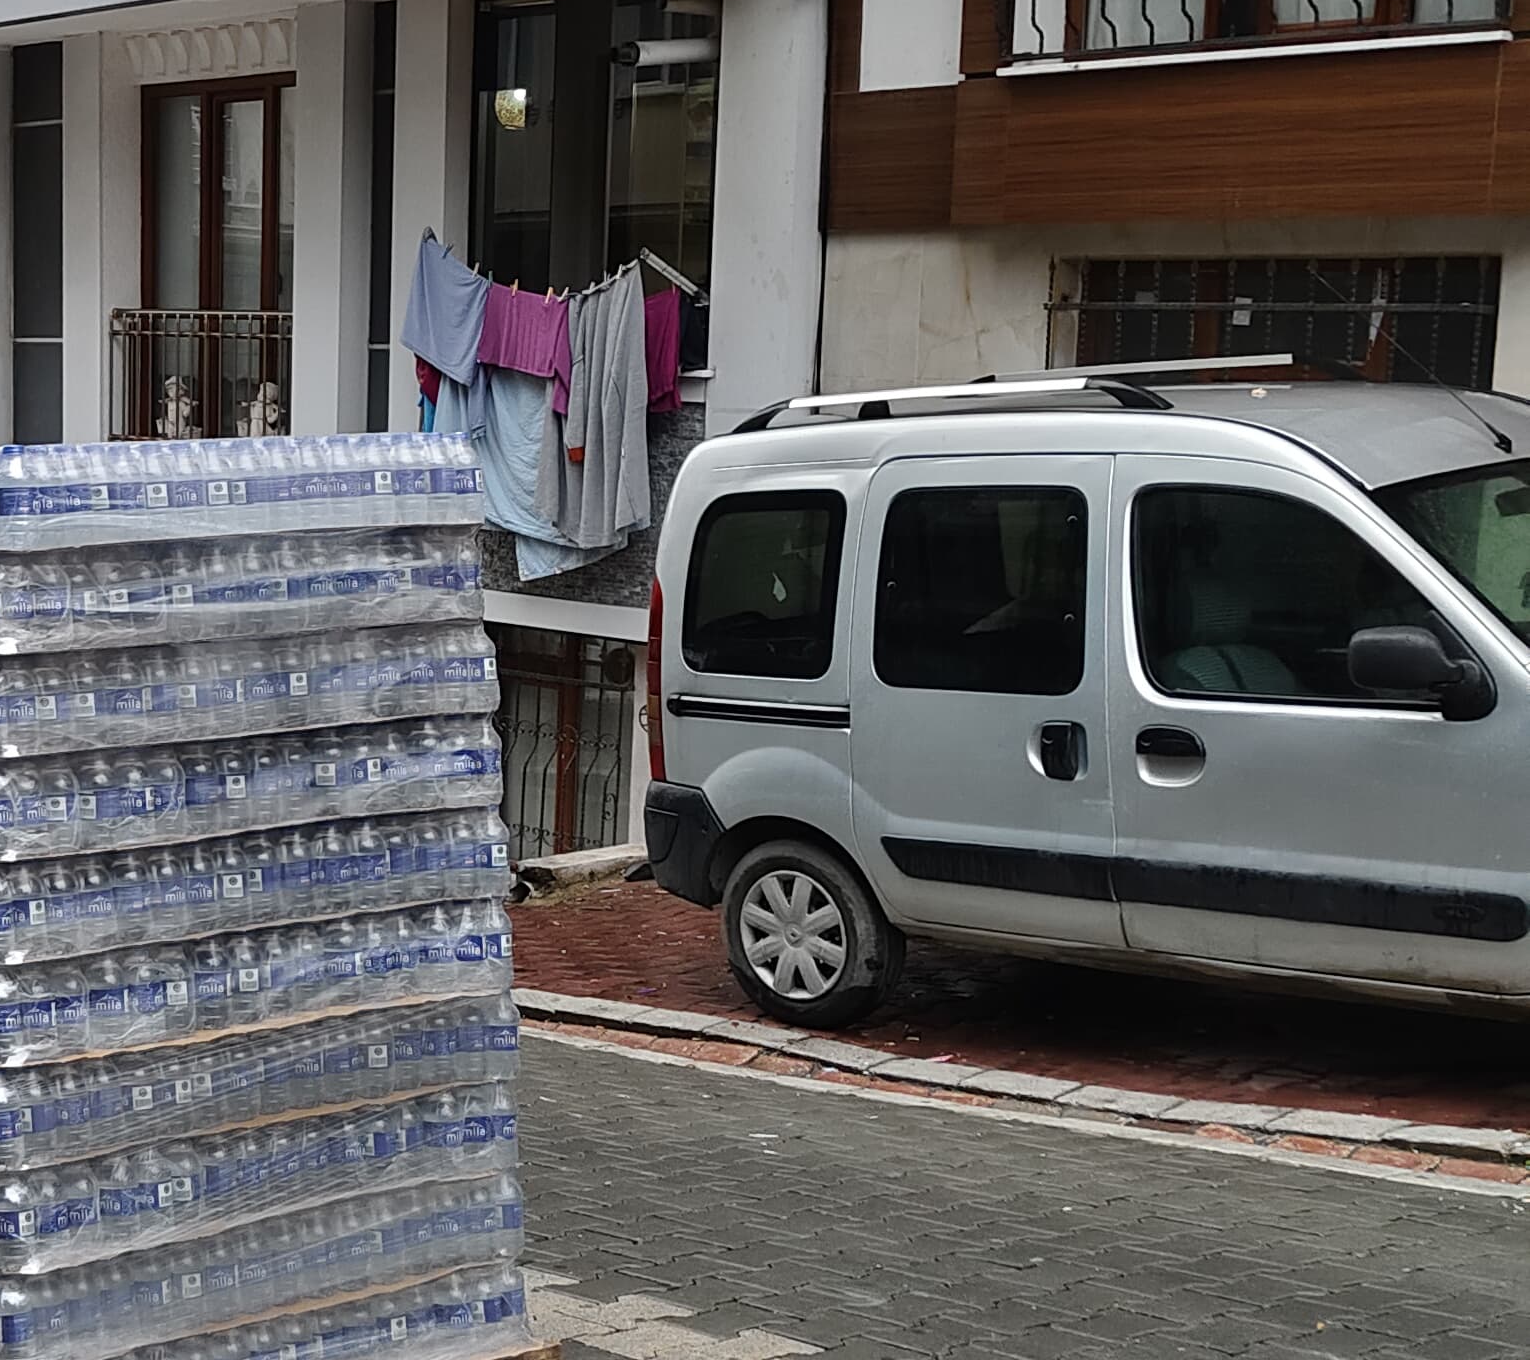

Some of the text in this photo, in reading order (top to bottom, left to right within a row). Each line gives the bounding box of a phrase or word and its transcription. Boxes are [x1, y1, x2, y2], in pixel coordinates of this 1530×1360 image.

[37, 600, 62, 612] mila
[410, 666, 435, 678] mila
[444, 666, 467, 678] mila
[9, 705, 35, 717] mila
[116, 698, 141, 711] mila
[188, 886, 213, 899] mila
[88, 900, 112, 913] mila
[1, 911, 26, 924] mila
[428, 946, 452, 958] mila
[457, 944, 480, 956] mila
[327, 958, 352, 972] mila
[199, 980, 224, 993] mila
[96, 998, 121, 1011] mila
[23, 1011, 49, 1024] mila
[493, 1033, 516, 1047] mila
[295, 1059, 319, 1072] mila
[208, 1275, 234, 1288] mila
